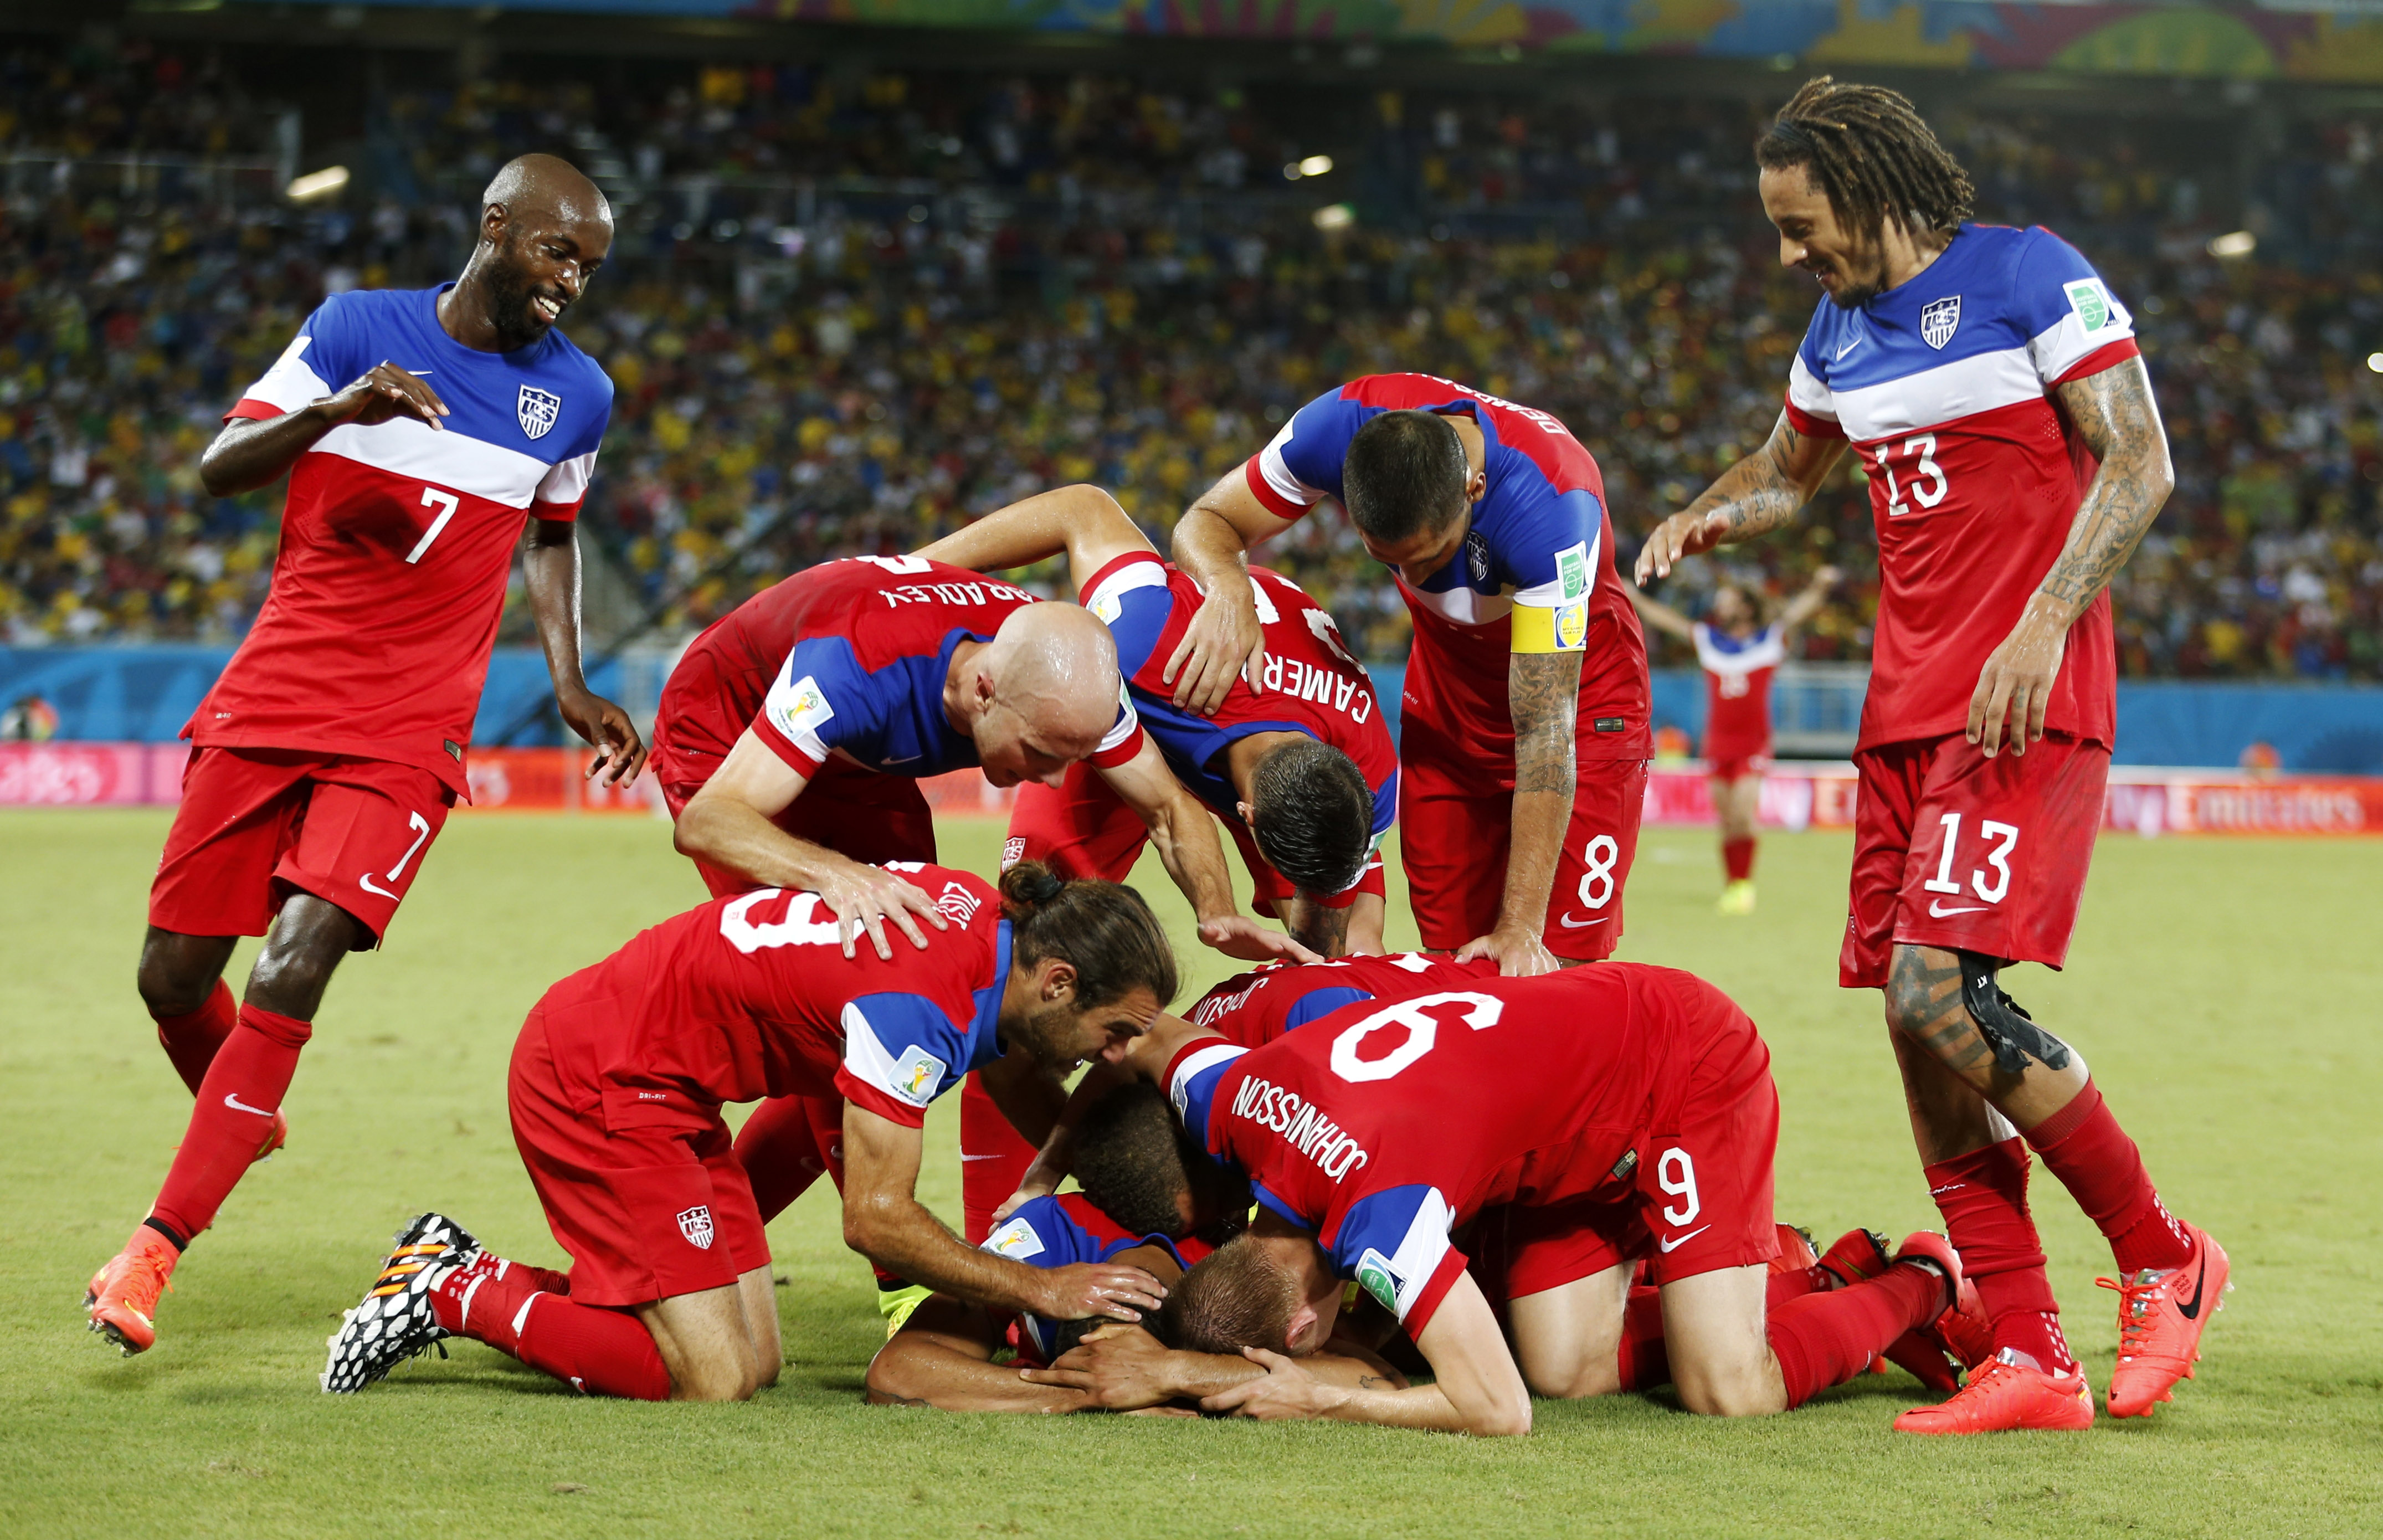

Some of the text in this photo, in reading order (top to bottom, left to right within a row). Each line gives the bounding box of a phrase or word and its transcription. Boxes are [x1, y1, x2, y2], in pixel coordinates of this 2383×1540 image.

[1405, 372, 1567, 435] DEMPS
[1874, 432, 1948, 517] 13
[405, 486, 460, 564] 7
[878, 581, 1035, 609] BRADLEY
[1563, 561, 1581, 571] FOOTBALL
[1240, 651, 1372, 725] CAMER
[386, 810, 430, 882] 7
[1578, 834, 1619, 909] 8
[1924, 812, 2019, 905] 13
[932, 881, 982, 931] ZUSI
[1977, 974, 1988, 989] KT
[1330, 991, 1505, 1084] 9
[638, 1092, 666, 1101] DRI-FIT
[1231, 1074, 1369, 1184] JOHANNSSON
[1657, 1147, 1701, 1227] 9
[1395, 1281, 1406, 1293] FIFA
